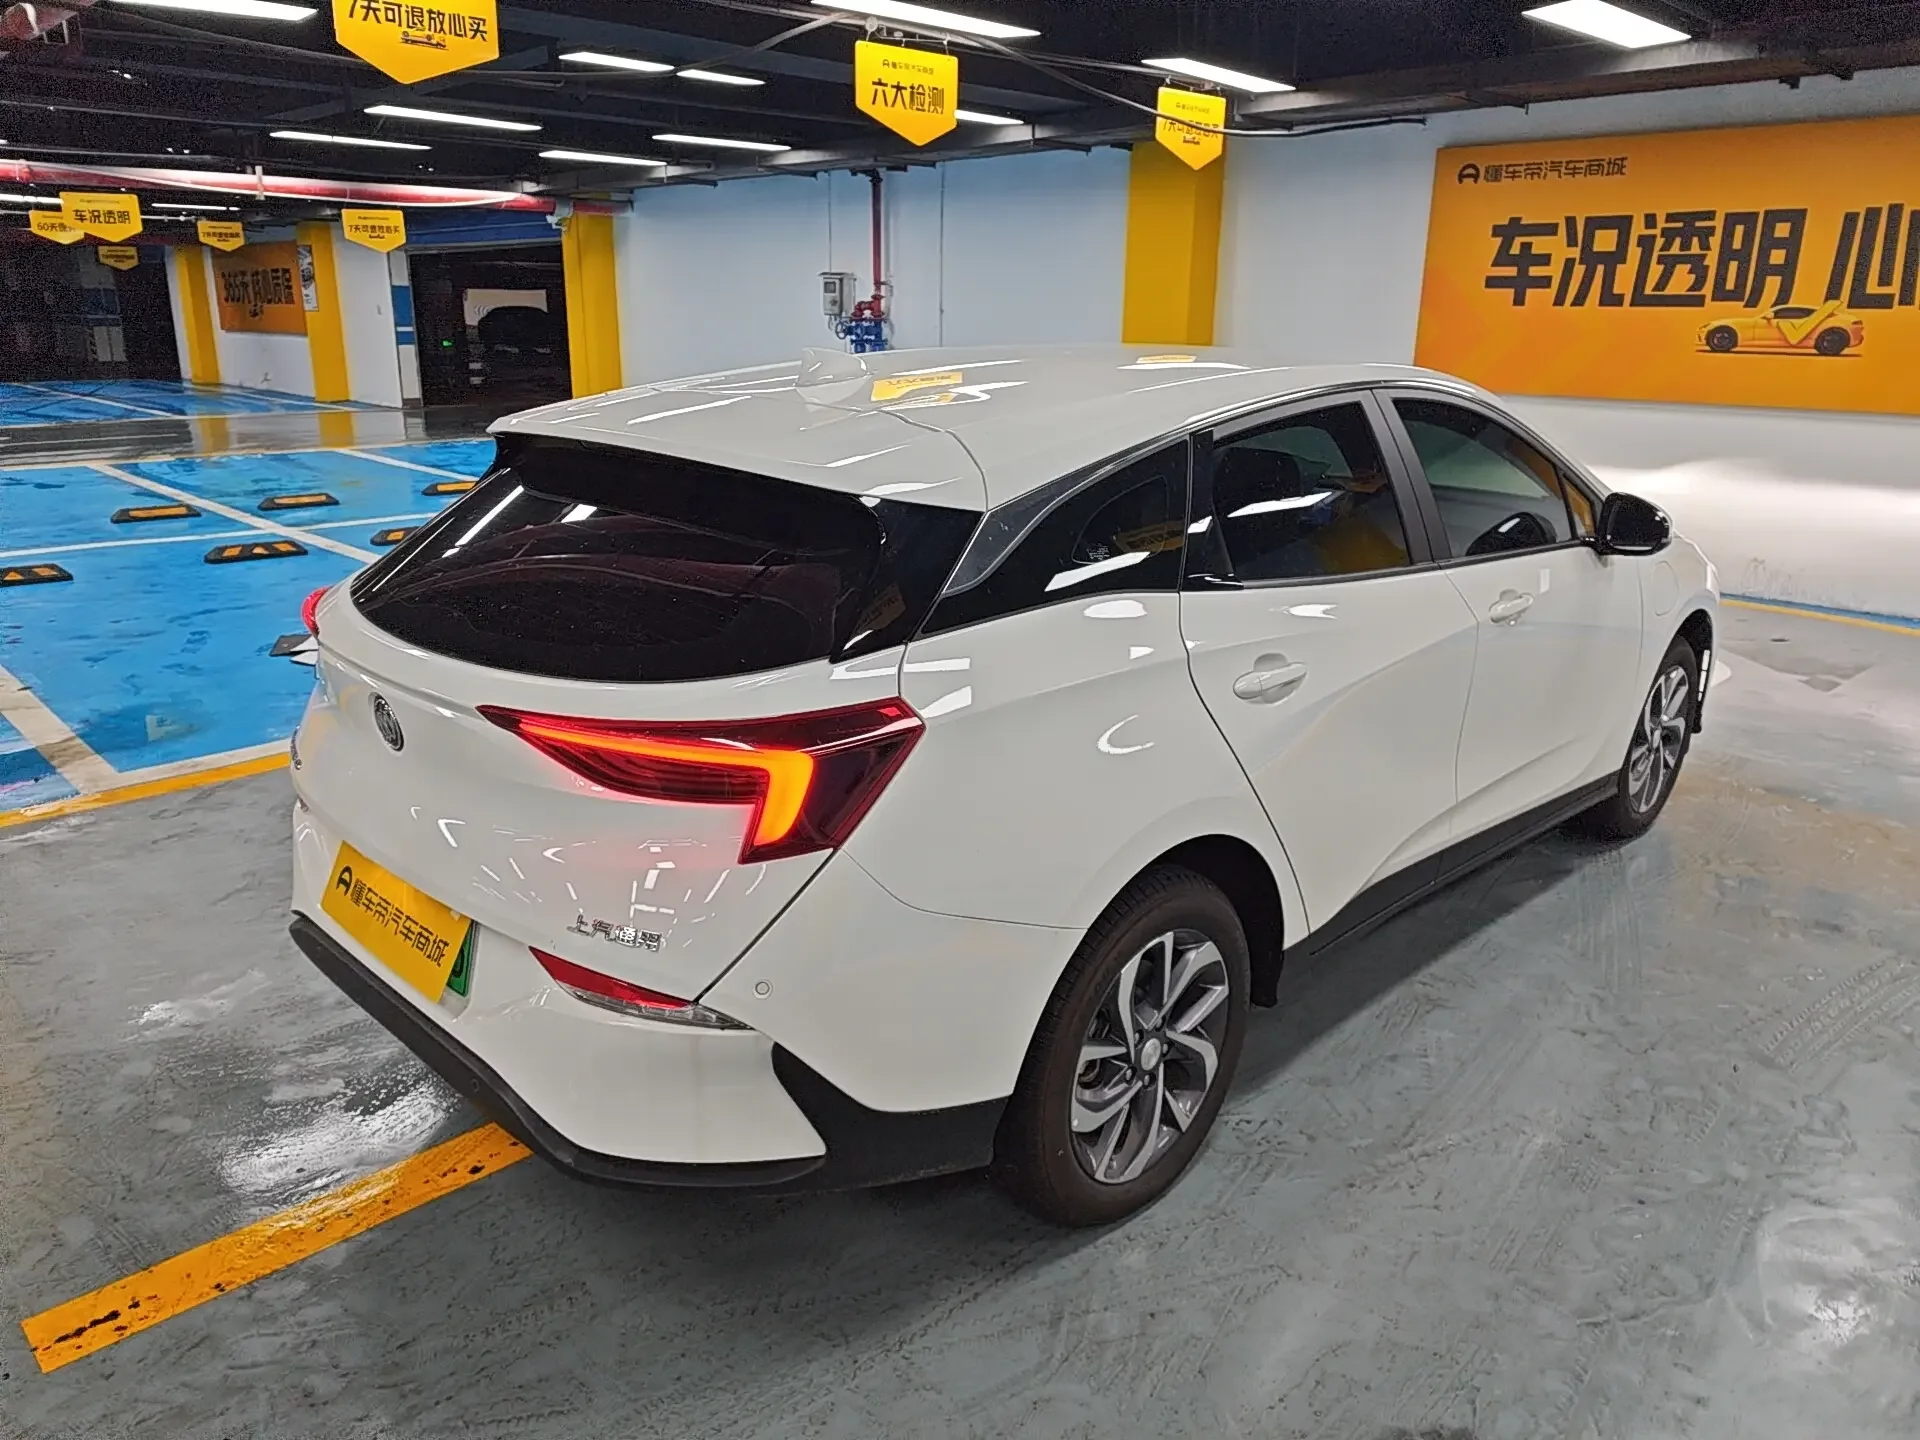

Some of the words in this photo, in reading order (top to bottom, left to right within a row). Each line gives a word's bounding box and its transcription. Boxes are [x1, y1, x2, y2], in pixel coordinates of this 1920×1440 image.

[872, 78, 945, 115] 六大检测
[1484, 156, 1629, 183] 懂车帝汽车商城
[72, 208, 132, 225] 车况透明
[1484, 208, 1808, 308] 车况透明
[1823, 203, 1920, 310] 心
[350, 877, 450, 968] 懂车帝汽车商城
